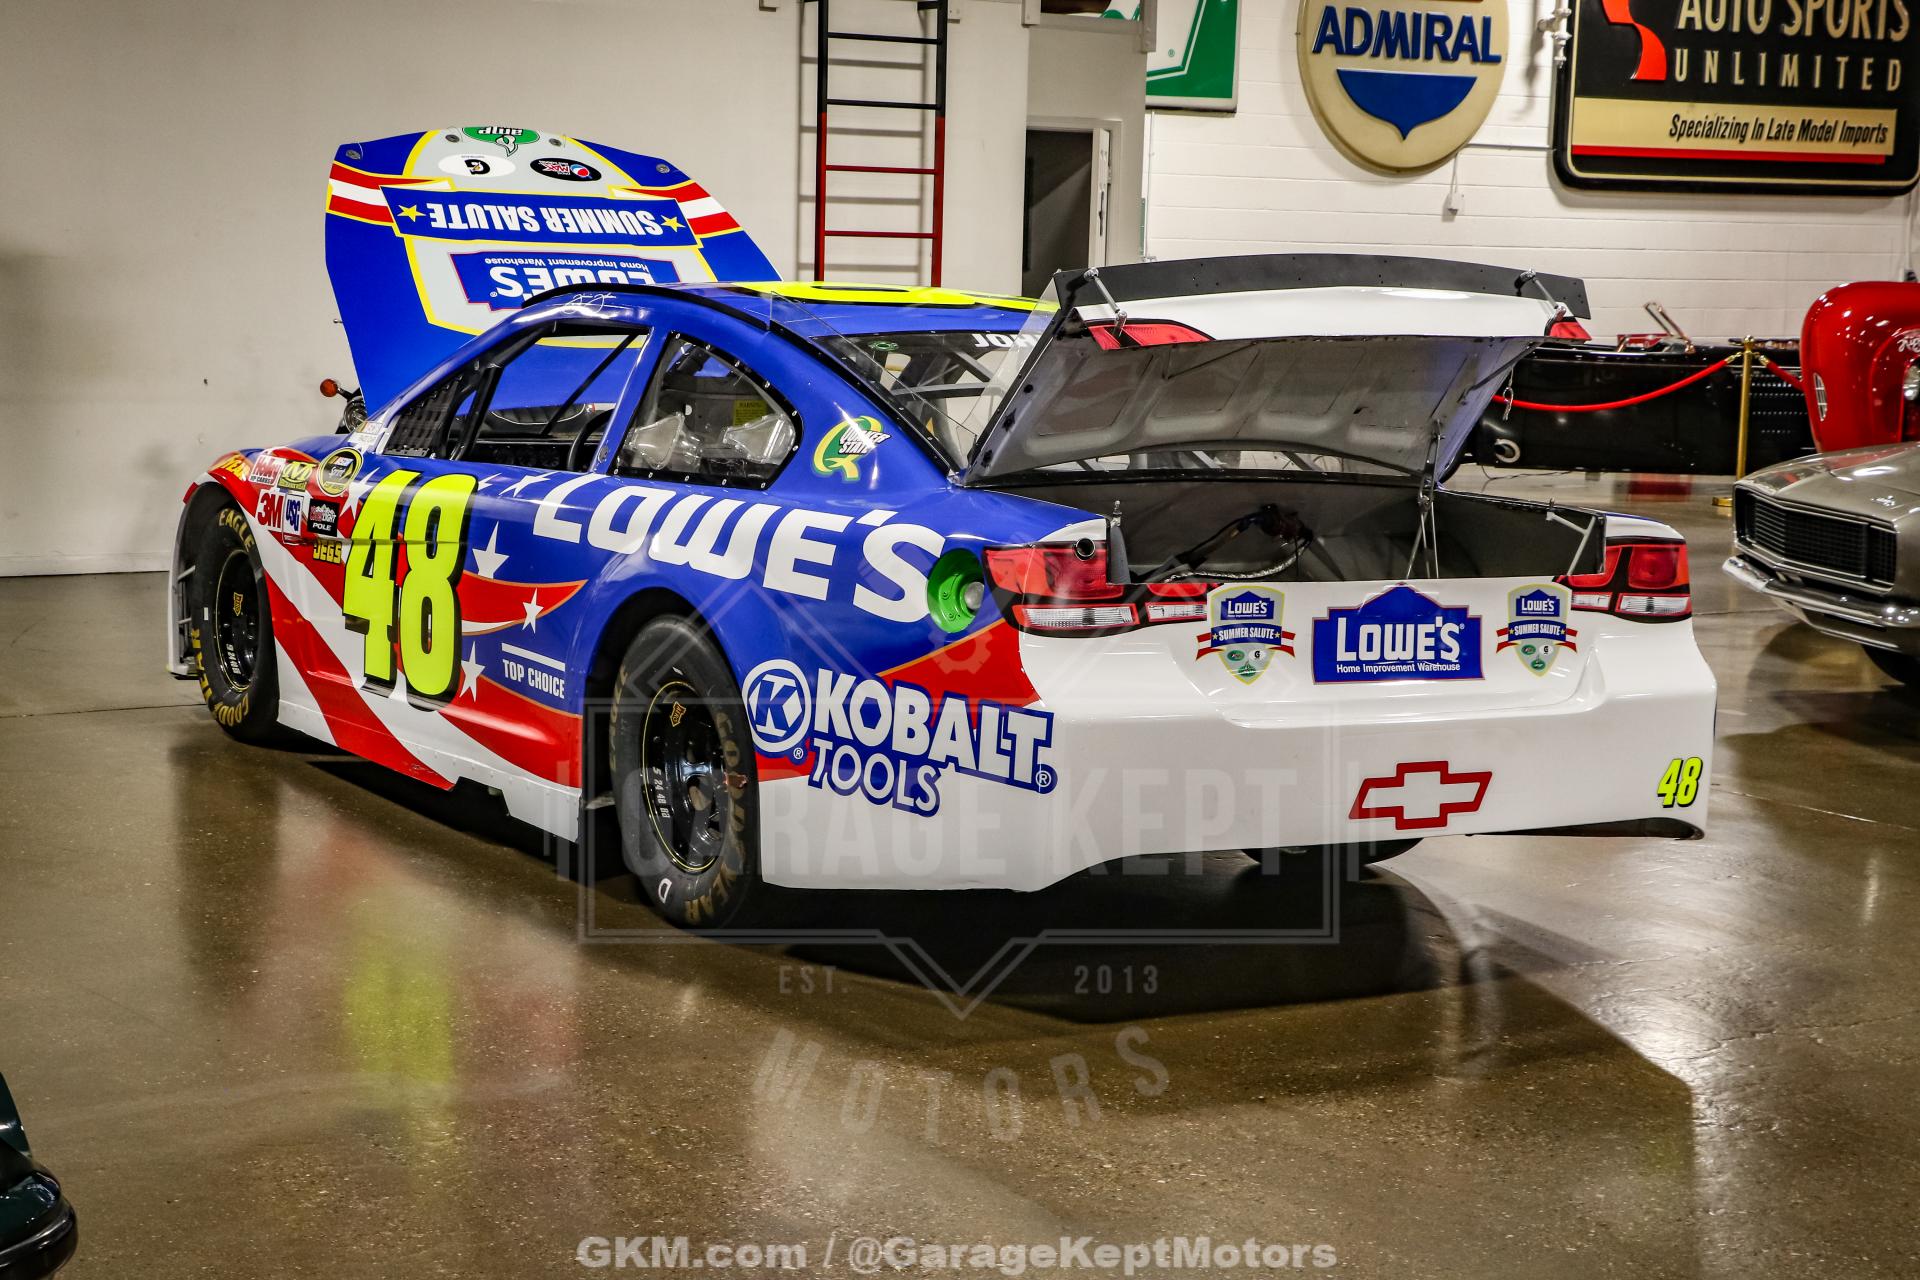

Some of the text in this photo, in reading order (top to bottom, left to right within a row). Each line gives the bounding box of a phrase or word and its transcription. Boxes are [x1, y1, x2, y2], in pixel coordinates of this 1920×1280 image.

[1311, 5, 1502, 64] ADMIRAL
[1674, 48, 1902, 91] UNLIMITED
[1669, 113, 1889, 147] Specializing In Late Model Imports
[426, 202, 664, 236] SUMMER SALUTE
[484, 257, 649, 273] Home Improvement Warehouse
[257, 493, 284, 529] 3M
[313, 523, 332, 531] POLE
[219, 508, 255, 552] EAGLE
[313, 541, 342, 564] JEGS
[532, 472, 946, 624] LOWE'S
[342, 468, 479, 706] 48
[1227, 600, 1268, 614] LOWE'S
[1521, 597, 1555, 612] LOWE'S
[1218, 626, 1275, 641] SUMMER SALUTE
[1336, 615, 1461, 662] LOWE'S
[1514, 623, 1561, 636] SUMMER SALUTE
[503, 659, 565, 699] TOP CHOICE
[1336, 662, 1461, 674] Home Improvement Warehouse
[813, 668, 1048, 784] KOBALT
[653, 779, 664, 791] 24
[810, 738, 940, 812] TOOLS
[1656, 756, 1704, 809] 48
[656, 793, 667, 806] 48
